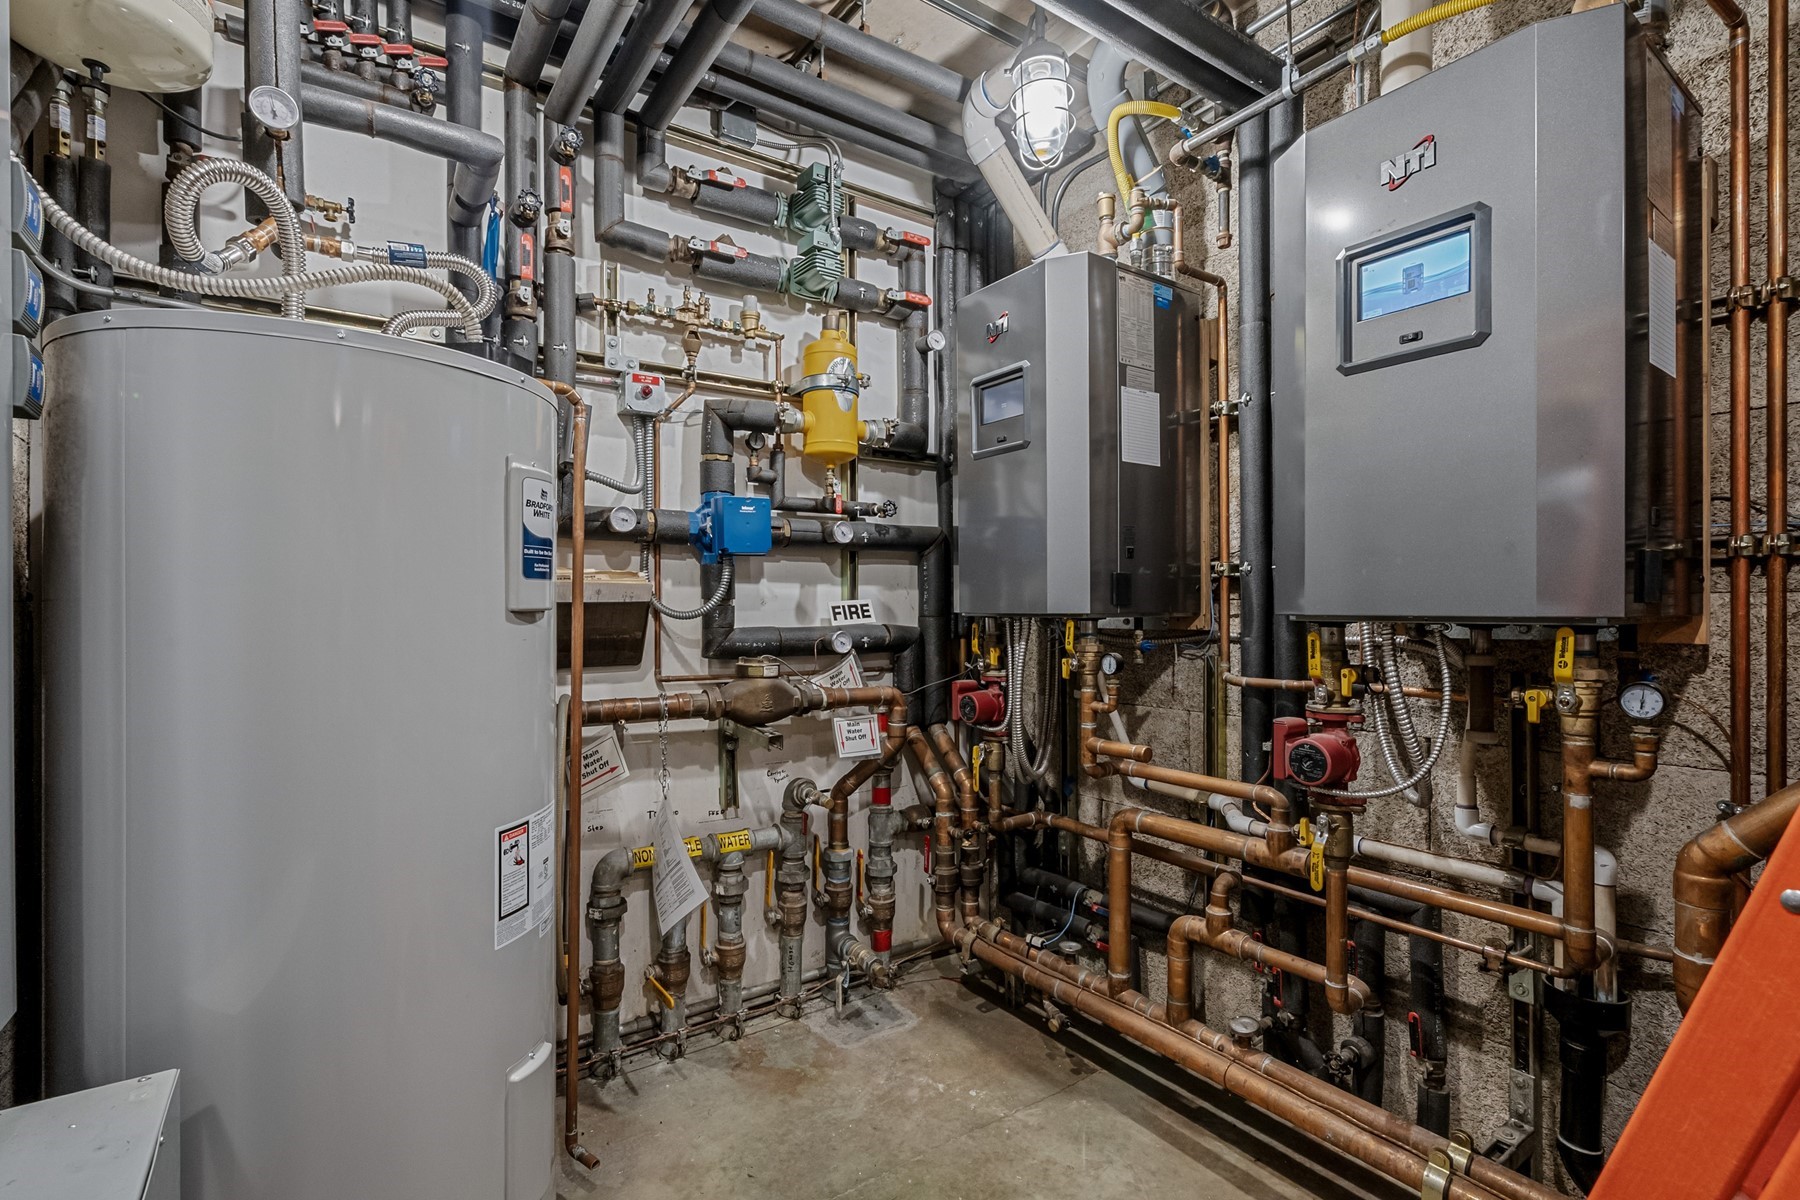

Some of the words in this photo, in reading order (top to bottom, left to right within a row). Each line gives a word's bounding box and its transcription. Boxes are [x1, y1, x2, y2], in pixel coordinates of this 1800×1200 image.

[1380, 138, 1437, 188] NTI
[985, 314, 1009, 341] NTI
[533, 508, 550, 519] WHITE
[831, 603, 872, 621] FIRE
[829, 670, 843, 681] Main
[829, 674, 847, 688] Water
[582, 749, 600, 761] Main
[582, 755, 604, 770] Water
[581, 768, 599, 780] Shut
[598, 759, 611, 770] Off
[719, 833, 751, 849] WATER
